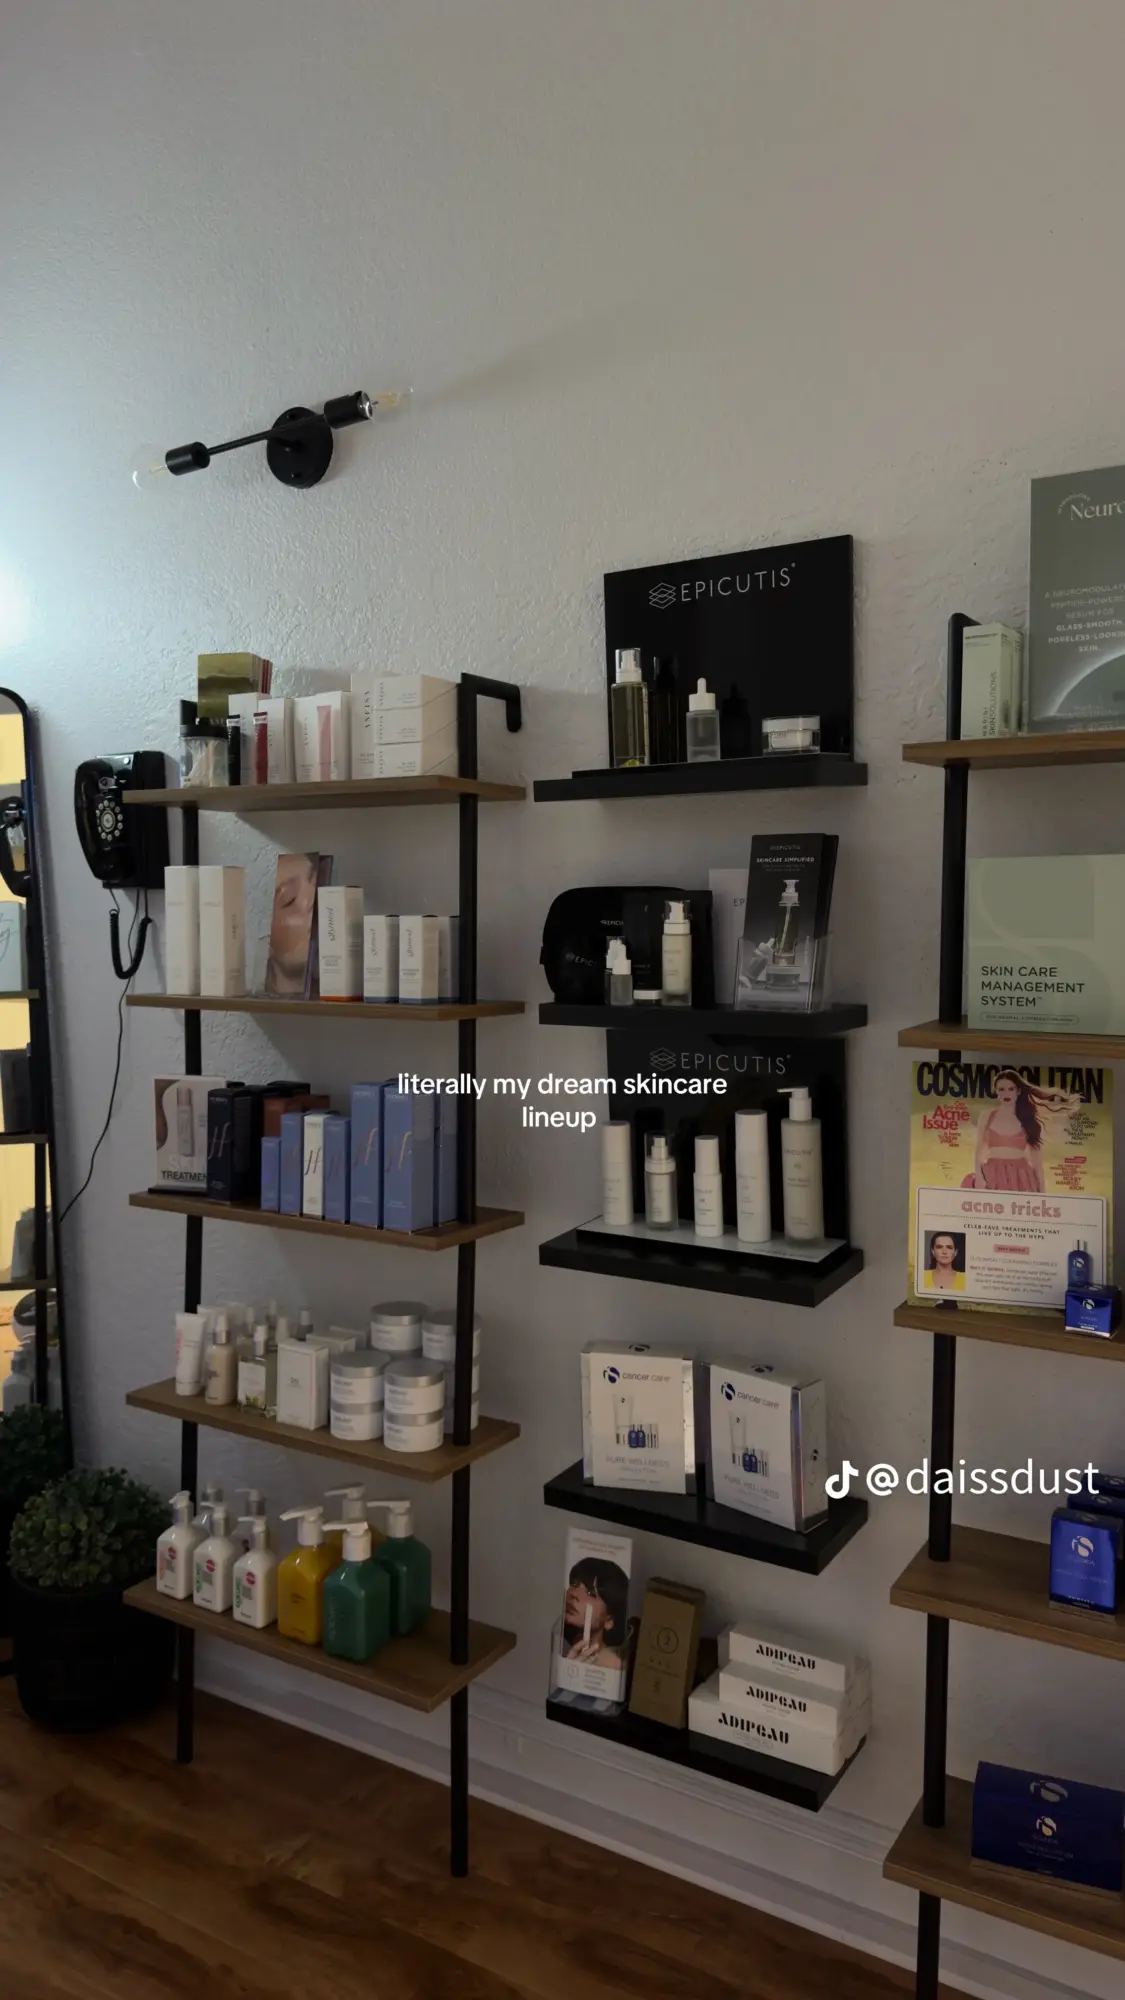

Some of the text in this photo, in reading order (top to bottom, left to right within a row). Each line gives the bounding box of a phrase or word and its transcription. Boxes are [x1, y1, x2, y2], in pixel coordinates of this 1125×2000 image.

[981, 966, 1058, 977] SKIN CARE
[981, 981, 1085, 993] MANAGEMENT
[932, 1104, 970, 1121] Acne
[923, 1114, 958, 1131] Issue
[961, 1199, 1062, 1218] acne tricks
[1002, 1226, 1042, 1234] TREATMENTS
[622, 1373, 649, 1381] cancer
